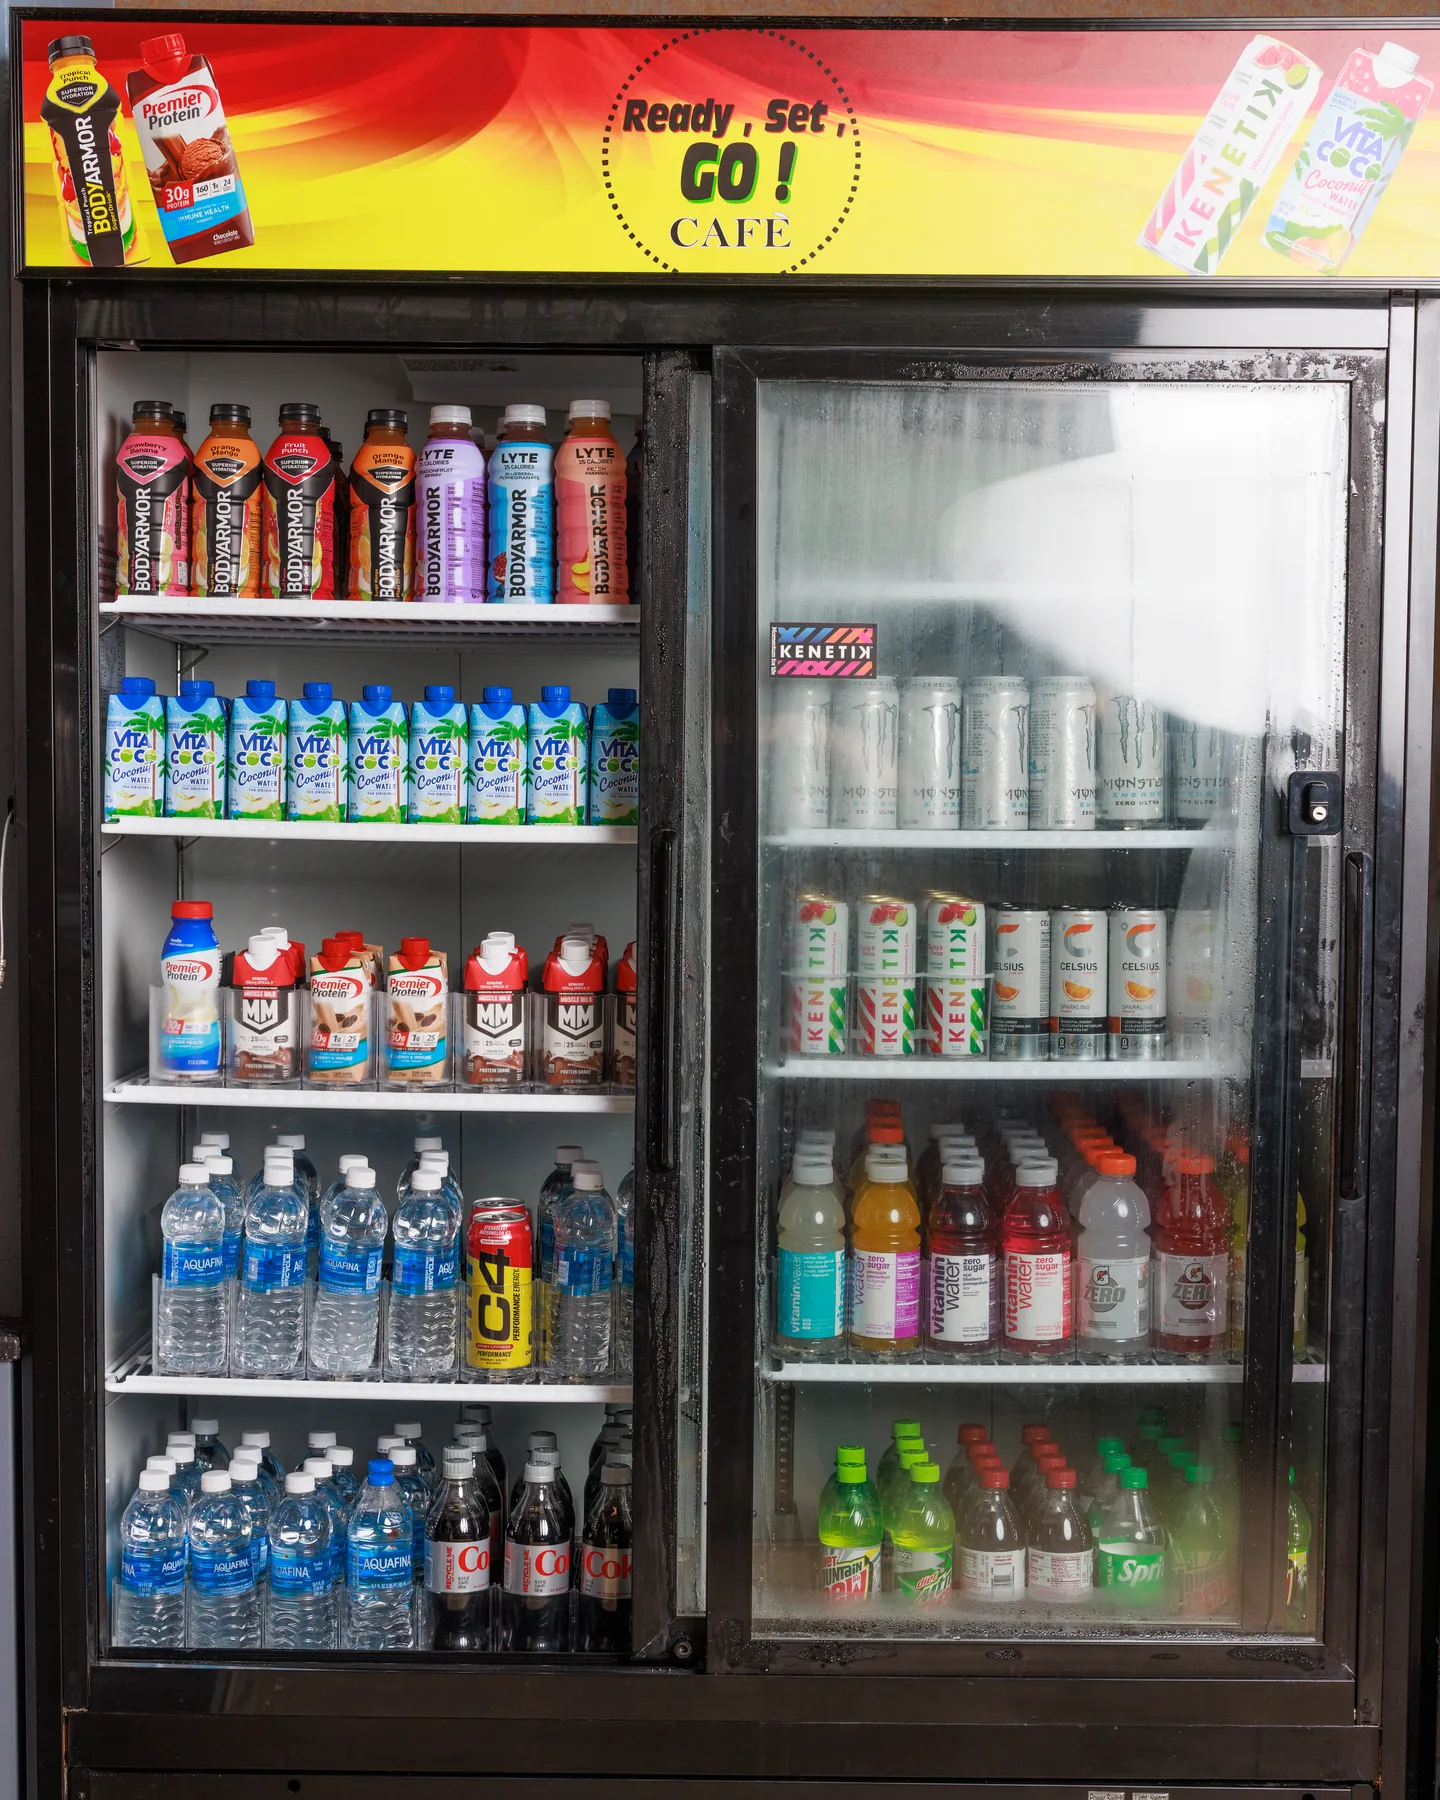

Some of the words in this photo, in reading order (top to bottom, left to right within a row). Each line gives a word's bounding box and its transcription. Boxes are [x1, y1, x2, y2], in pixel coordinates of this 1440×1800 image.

[60, 86, 94, 96] SUPERIOR
[61, 90, 94, 101] HYDRATION
[143, 90, 202, 119] Premier
[149, 106, 201, 130] Protein
[622, 98, 735, 138] Ready
[764, 98, 828, 134] Set
[1250, 122, 1282, 170] Watermelon
[1334, 116, 1384, 162] VITA
[1317, 140, 1382, 182] COCO
[75, 115, 111, 234] BODYARMOR
[680, 142, 760, 204] GO
[196, 185, 208, 194] 160
[1304, 169, 1376, 196] Coconut
[165, 186, 190, 203] 30g
[1330, 191, 1358, 210] WATER
[167, 200, 190, 209] PROTEIN
[178, 212, 203, 222] IMMUNE
[204, 204, 230, 216] HEALTH
[213, 230, 238, 240] Chocolate
[125, 442, 168, 452] Strawberry
[212, 450, 238, 458] Mango
[419, 449, 454, 462] LYTE
[576, 448, 615, 458] LYTE
[501, 452, 539, 464] LYTE
[135, 488, 151, 591] BODYARMOR
[214, 491, 231, 594] BODYARMOR
[287, 488, 302, 593] BODYARMOR
[380, 498, 396, 598] BODYARMOR
[426, 486, 440, 596] BODYARMOR
[510, 489, 527, 598] BODYARMOR
[590, 484, 610, 595] BODYARMOR
[780, 644, 871, 659] KENETIK
[114, 729, 152, 748] VITA
[172, 730, 210, 750] VITA
[240, 732, 278, 752] VITA
[296, 734, 335, 753] VITA
[356, 736, 396, 755] VITA
[418, 736, 457, 756] VITA
[477, 737, 516, 758] VITA
[535, 736, 574, 756] VITA
[111, 748, 158, 763] COCO
[600, 738, 638, 758] VITA
[170, 750, 216, 765] COCO
[236, 752, 282, 767] COCO
[294, 754, 340, 768] COCO
[354, 756, 401, 770] COCO
[416, 756, 462, 770] COCO
[474, 758, 520, 772] COCO
[532, 756, 578, 772] COCO
[112, 763, 151, 782] Coconut
[131, 776, 152, 784] WATER
[172, 763, 210, 785] Coconut
[238, 764, 278, 786] Coconut
[296, 766, 336, 788] Coconut
[357, 767, 398, 790] Coconut
[418, 768, 458, 790] Coconut
[476, 770, 516, 792] Coconut
[600, 770, 638, 792] Coconut
[376, 782, 396, 790] WATER
[166, 960, 201, 974] Premier
[1060, 962, 1098, 971] CELSIUS
[1122, 962, 1160, 971] CELSIUS
[167, 971, 198, 982] Protein
[312, 980, 352, 990] Premier
[390, 978, 432, 989] Premier
[312, 987, 348, 998] Protein
[391, 986, 427, 997] Protein
[427, 1034, 436, 1042] 25
[183, 1256, 223, 1270] AQUAFINA
[324, 1257, 360, 1272] AQUAFINA
[867, 1262, 890, 1270] sugar
[963, 1264, 986, 1272] sugar
[1036, 1263, 1058, 1272] sugar
[855, 1254, 865, 1304] water
[946, 1258, 960, 1311] water
[1018, 1257, 1032, 1309] water
[478, 1248, 510, 1342] C4
[930, 1256, 945, 1334] vitamin
[1006, 1256, 1018, 1333] vitamin
[1084, 1286, 1126, 1303] ZERO
[476, 1350, 512, 1358] PERFORMANCE
[214, 1558, 249, 1573] AQUAFINA
[363, 1554, 412, 1572] AQUAFINA
[916, 1572, 938, 1589] diet
